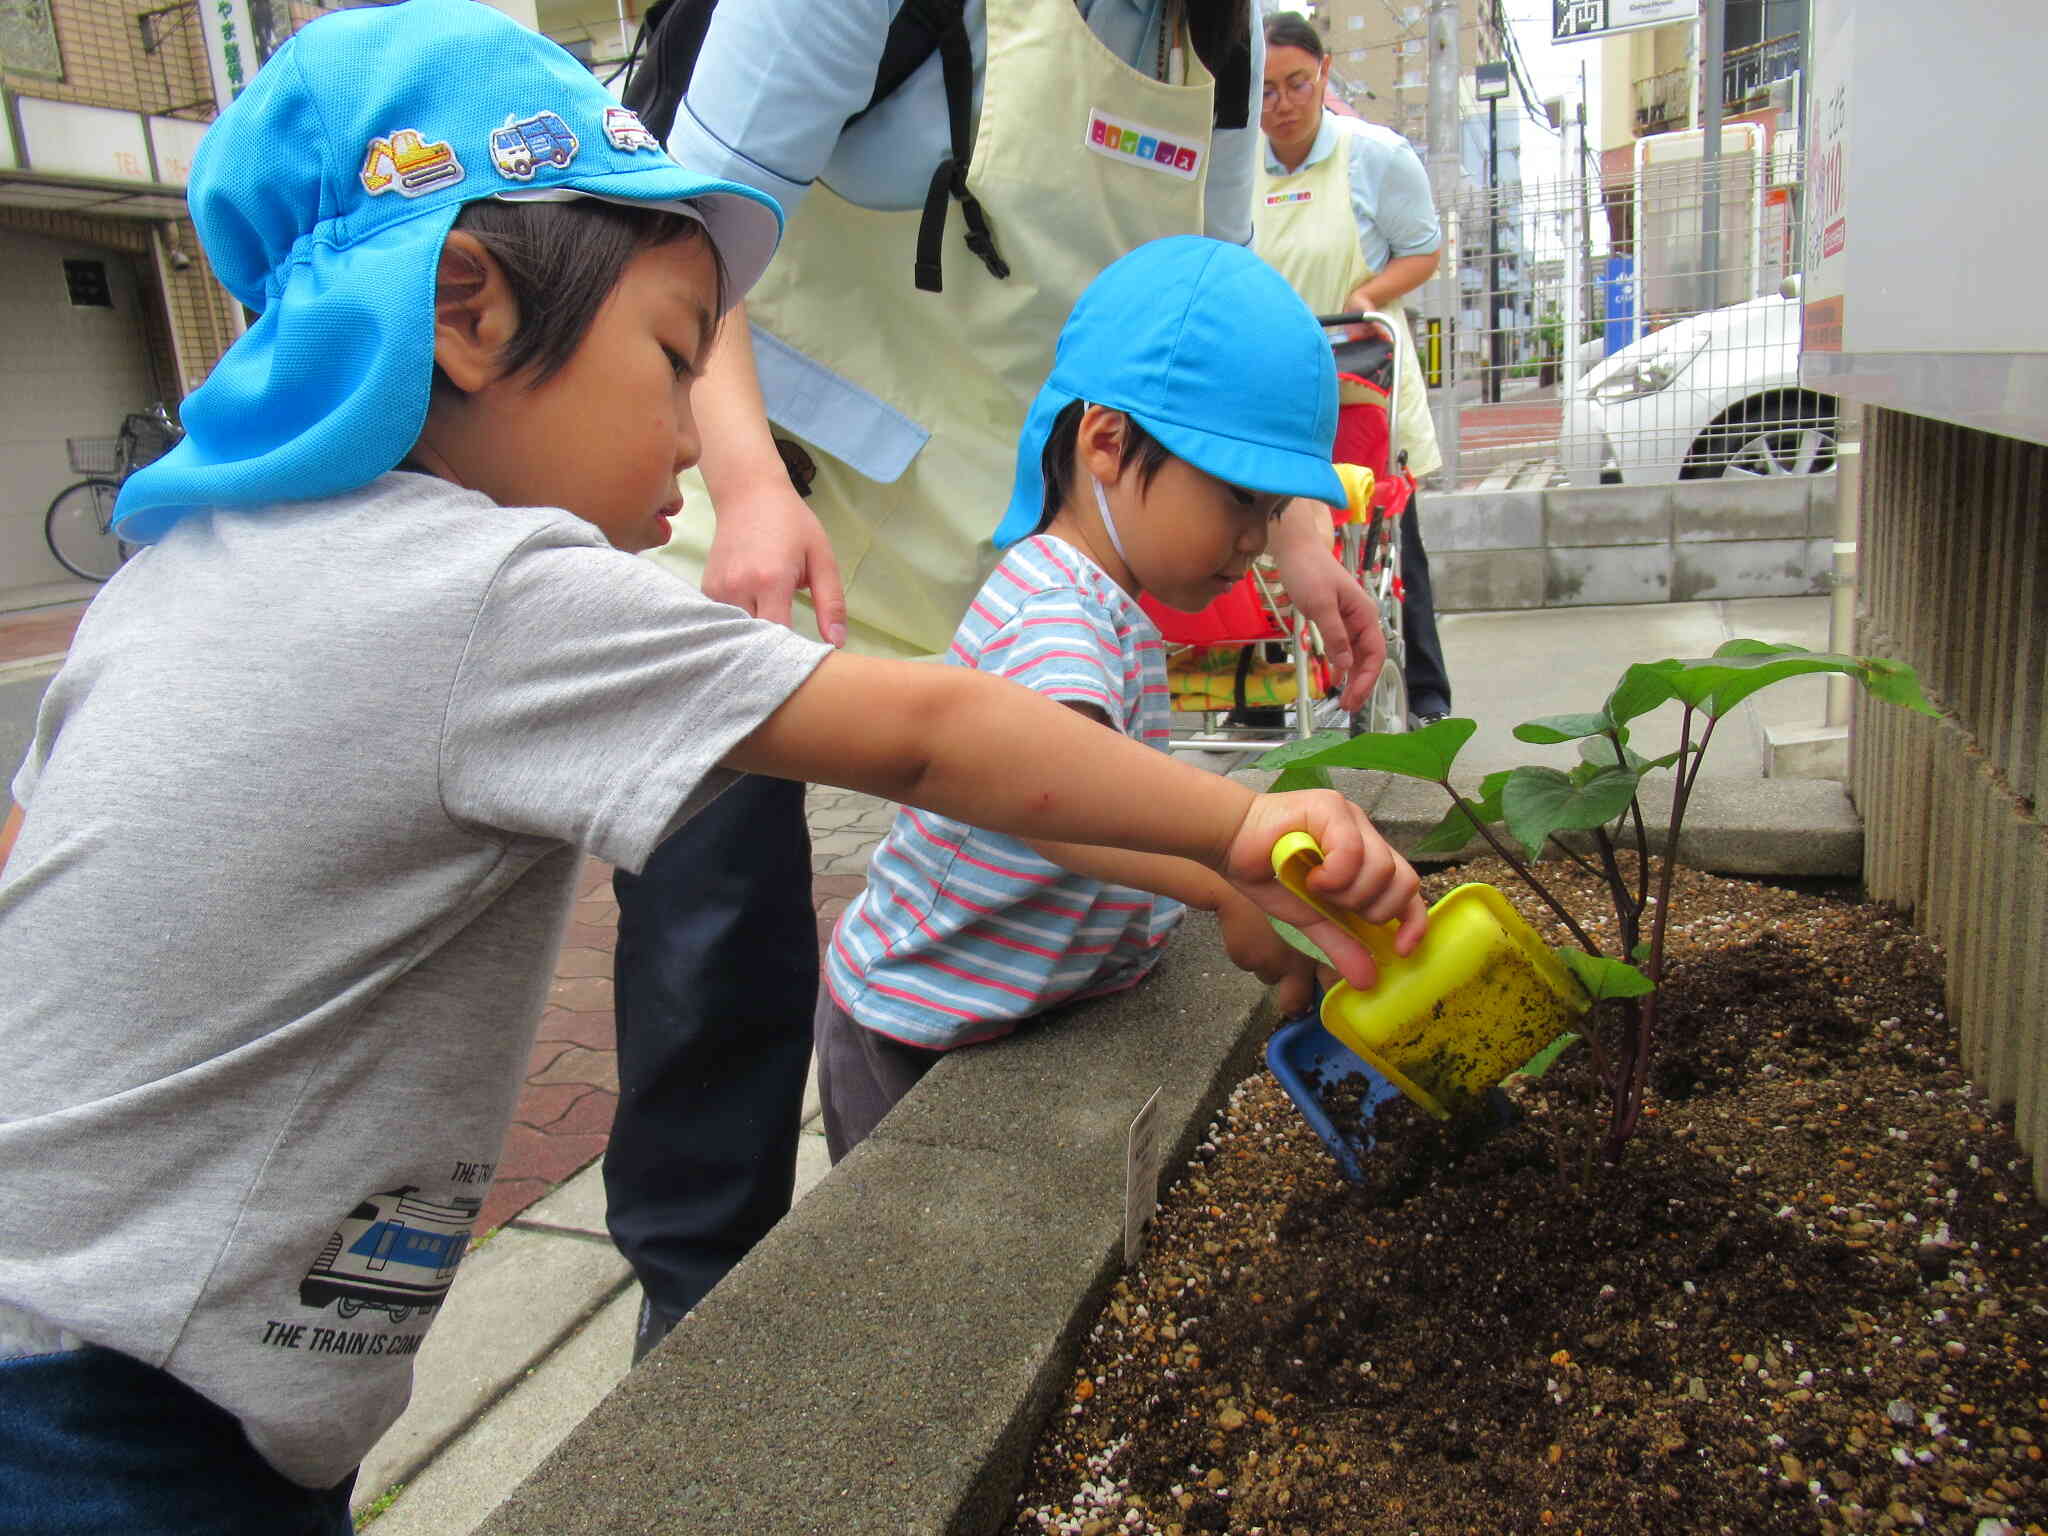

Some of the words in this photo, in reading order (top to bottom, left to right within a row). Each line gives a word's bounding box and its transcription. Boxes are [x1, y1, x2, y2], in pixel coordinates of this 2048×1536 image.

[451, 1161, 479, 1184] THE
[262, 1320, 307, 1348] THE
[309, 1327, 372, 1354] TRAIN
[366, 1334, 387, 1355] IS
